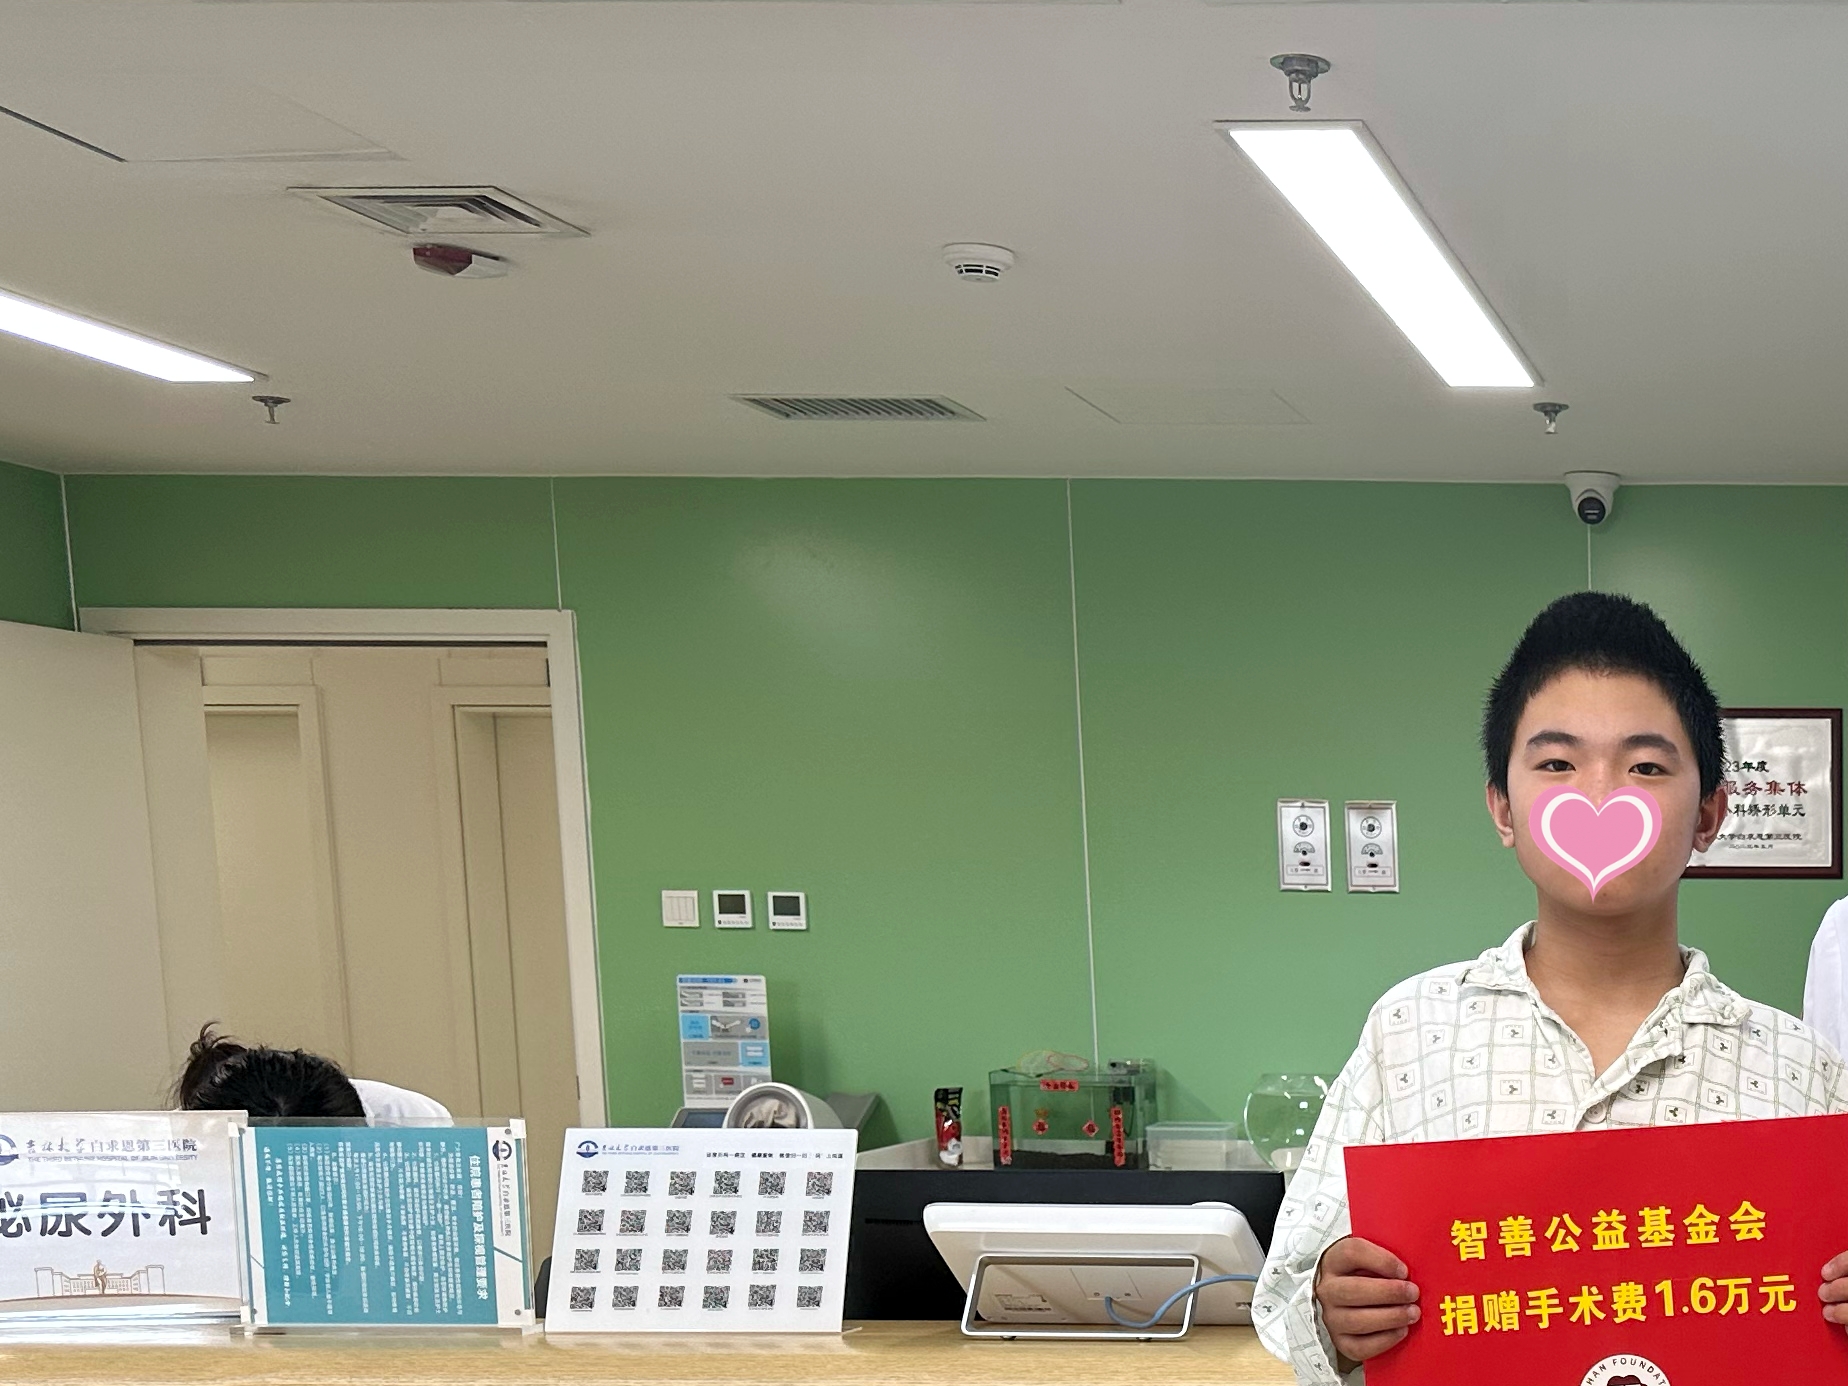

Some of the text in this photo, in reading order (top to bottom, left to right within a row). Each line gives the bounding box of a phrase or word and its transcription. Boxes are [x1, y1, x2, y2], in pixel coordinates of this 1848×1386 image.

[1727, 803, 1806, 818] 科矫形单元
[1450, 1200, 1766, 1261] 智善公益基金会
[1439, 1274, 1797, 1336] 捐赠手术费1.6万元
